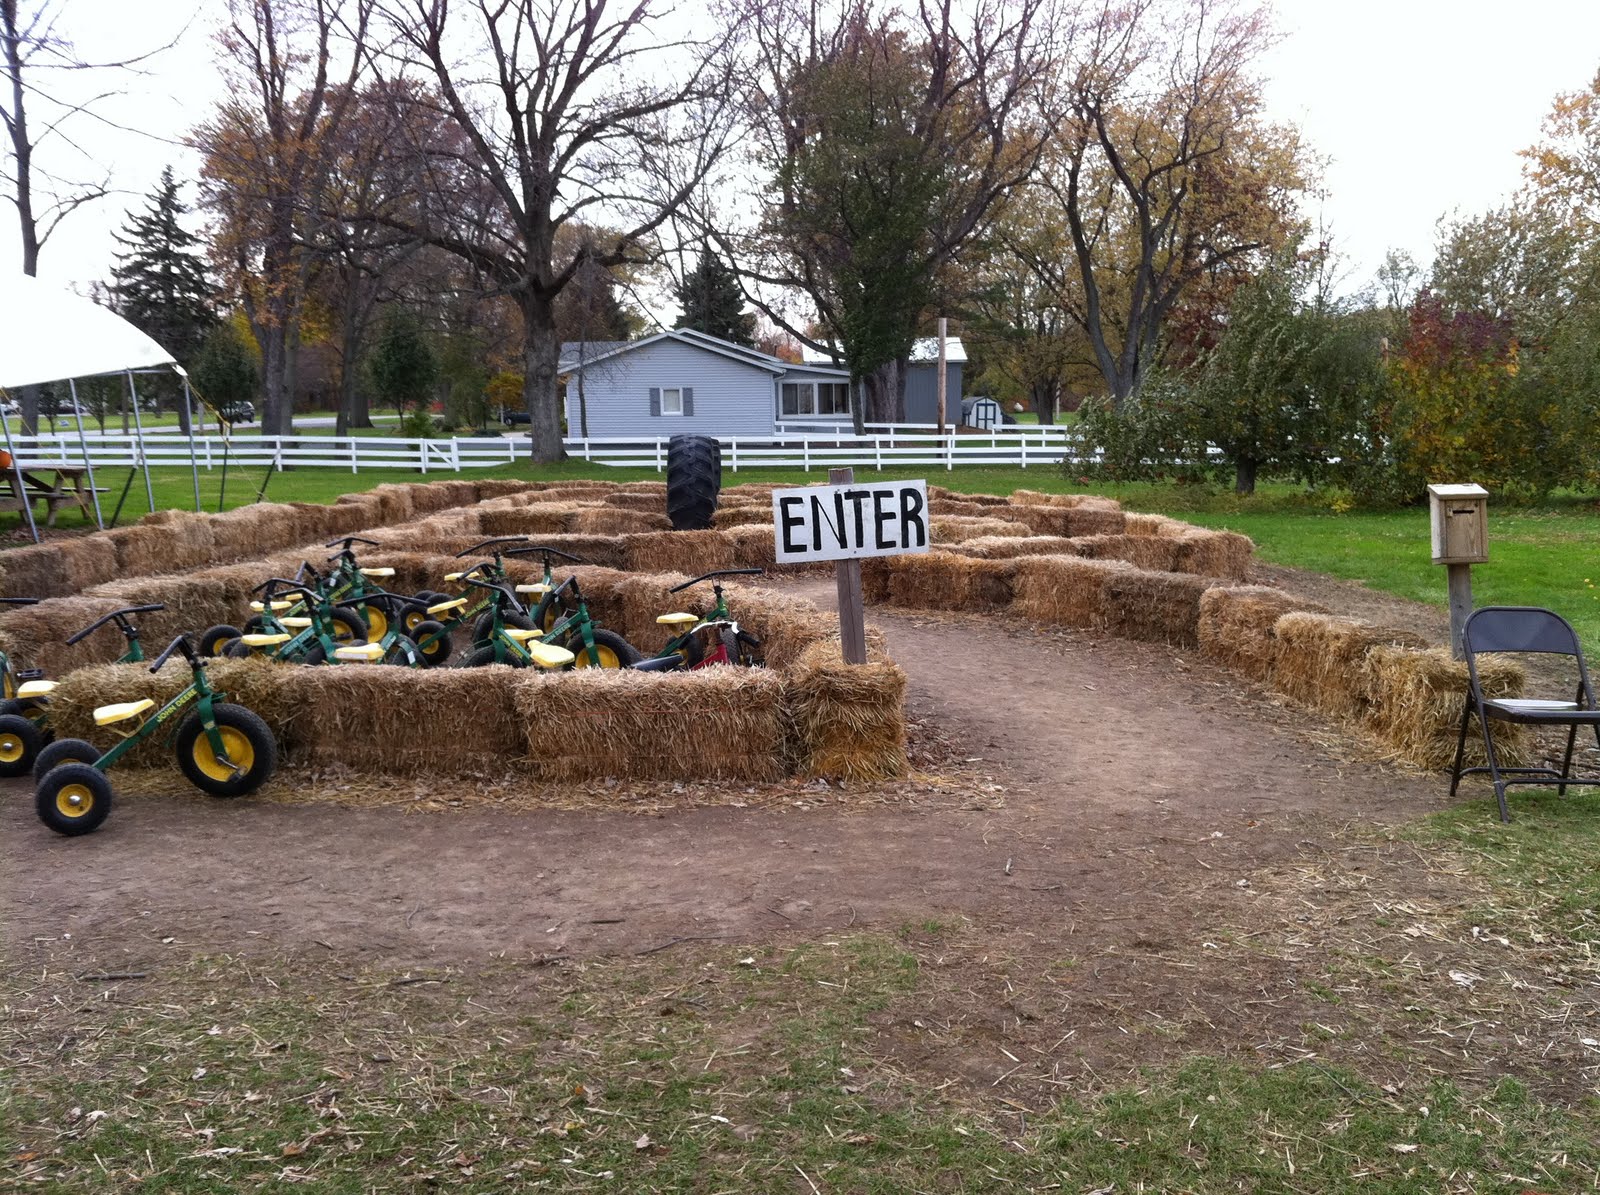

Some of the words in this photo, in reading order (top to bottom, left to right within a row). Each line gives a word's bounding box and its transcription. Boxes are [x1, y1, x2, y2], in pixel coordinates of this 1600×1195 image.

[779, 488, 926, 553] ENTER
[156, 704, 177, 723] JOHN
[176, 688, 198, 707] DEERE
